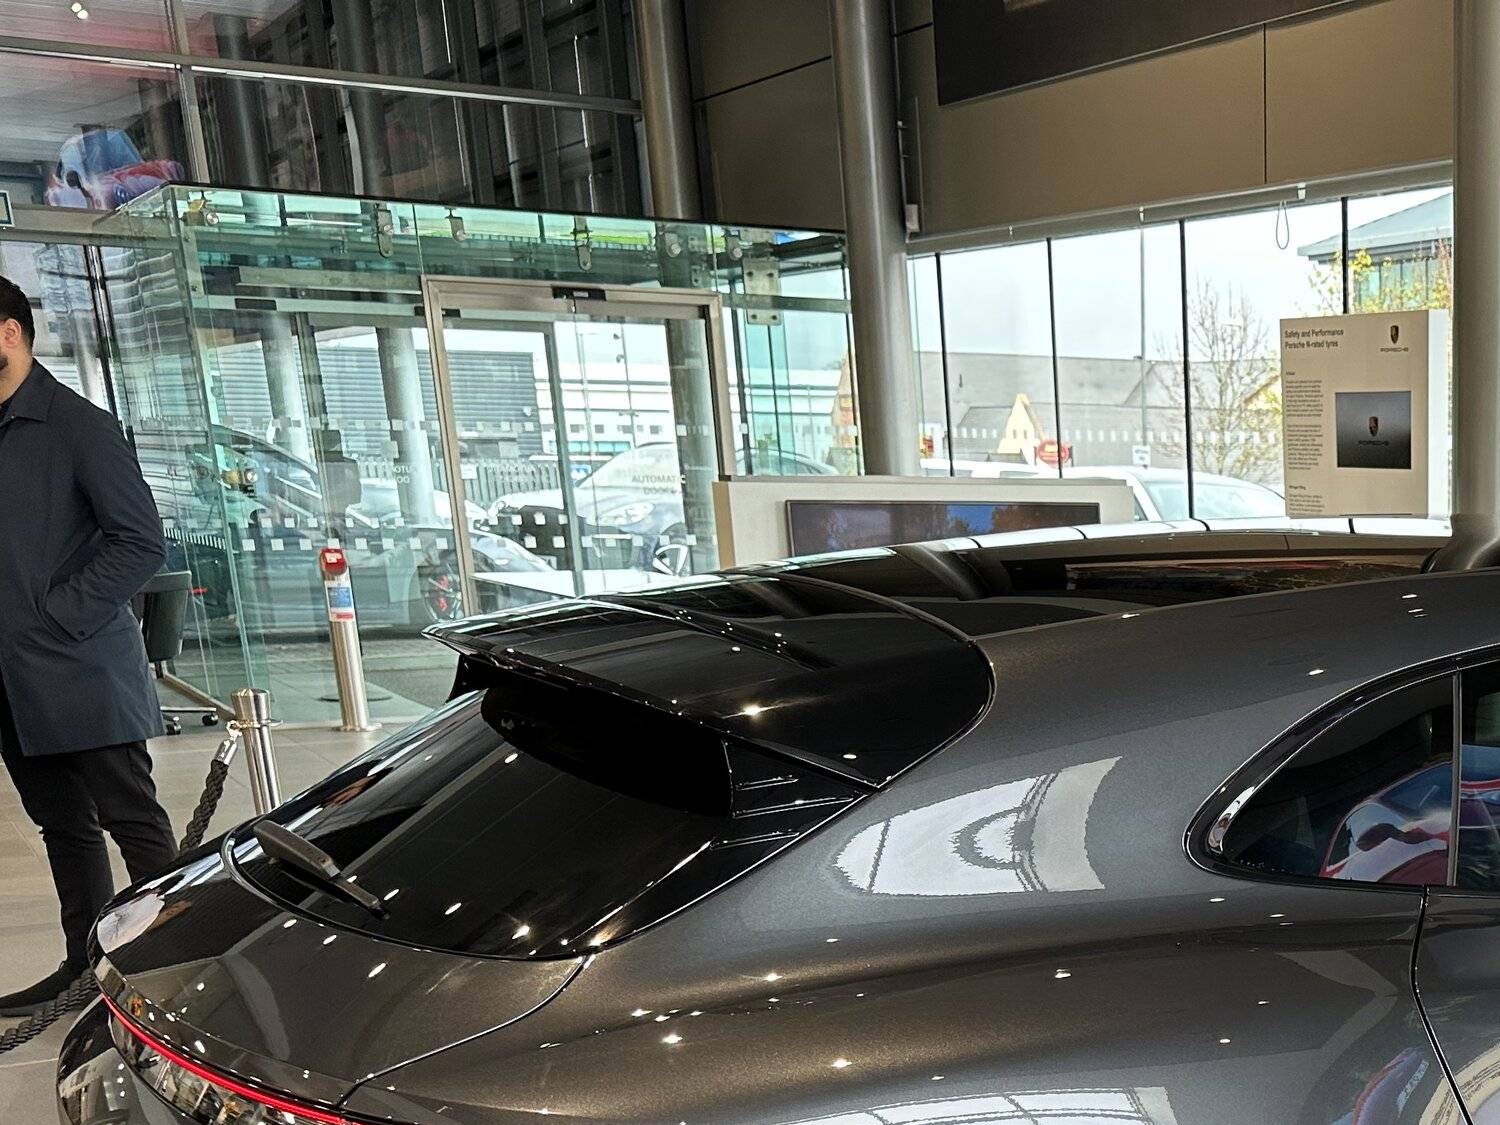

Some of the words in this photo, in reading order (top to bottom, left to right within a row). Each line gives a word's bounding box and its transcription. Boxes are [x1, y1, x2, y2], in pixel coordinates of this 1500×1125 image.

[1284, 330, 1300, 339] Safety
[1301, 329, 1311, 338] and
[1311, 328, 1344, 338] Performance
[1284, 341, 1305, 349] Porsche
